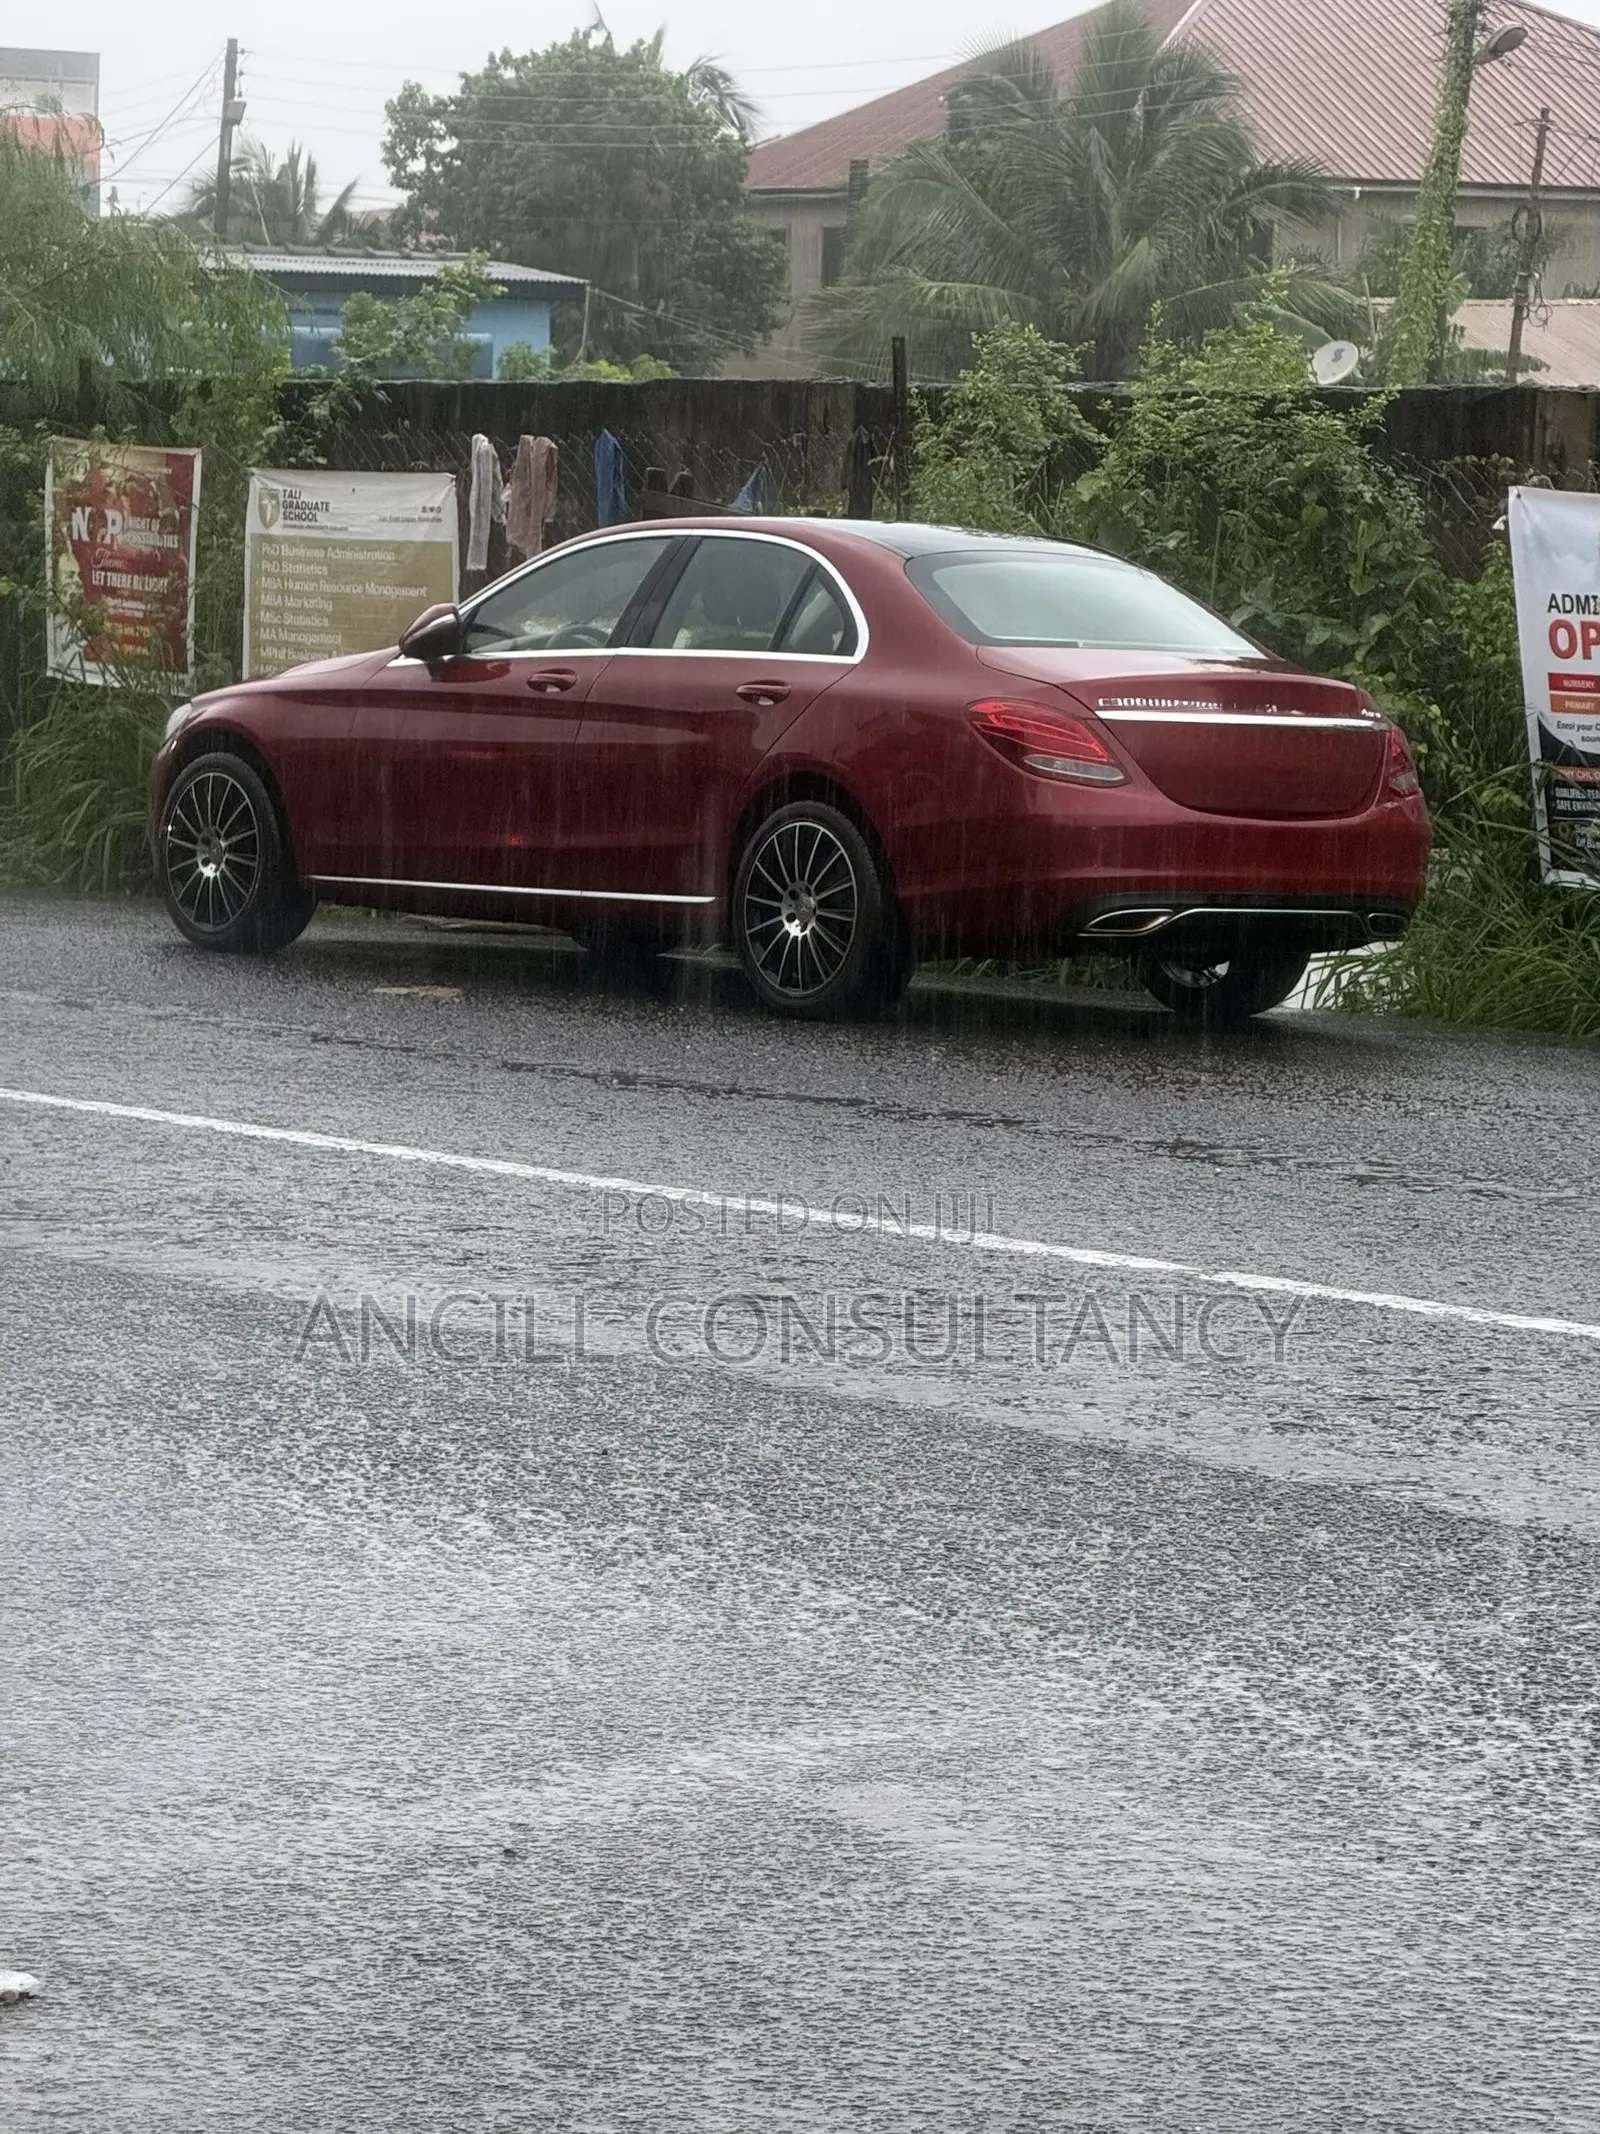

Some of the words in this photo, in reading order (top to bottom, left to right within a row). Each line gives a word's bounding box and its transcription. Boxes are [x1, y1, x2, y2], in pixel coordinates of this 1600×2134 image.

[282, 489, 302, 500] TALI
[282, 500, 330, 512] GRADUATE
[282, 511, 318, 522] SCHOOL
[282, 544, 325, 560] Business
[327, 546, 395, 561] Administration
[281, 561, 328, 575] Statistics
[261, 576, 282, 589] MBA
[284, 578, 318, 593] Human
[320, 579, 363, 594] Resource
[365, 581, 427, 598] Management
[260, 593, 282, 606] MBA
[284, 594, 333, 613] Marketing
[284, 613, 329, 627] Statistics
[279, 628, 341, 645] Management
